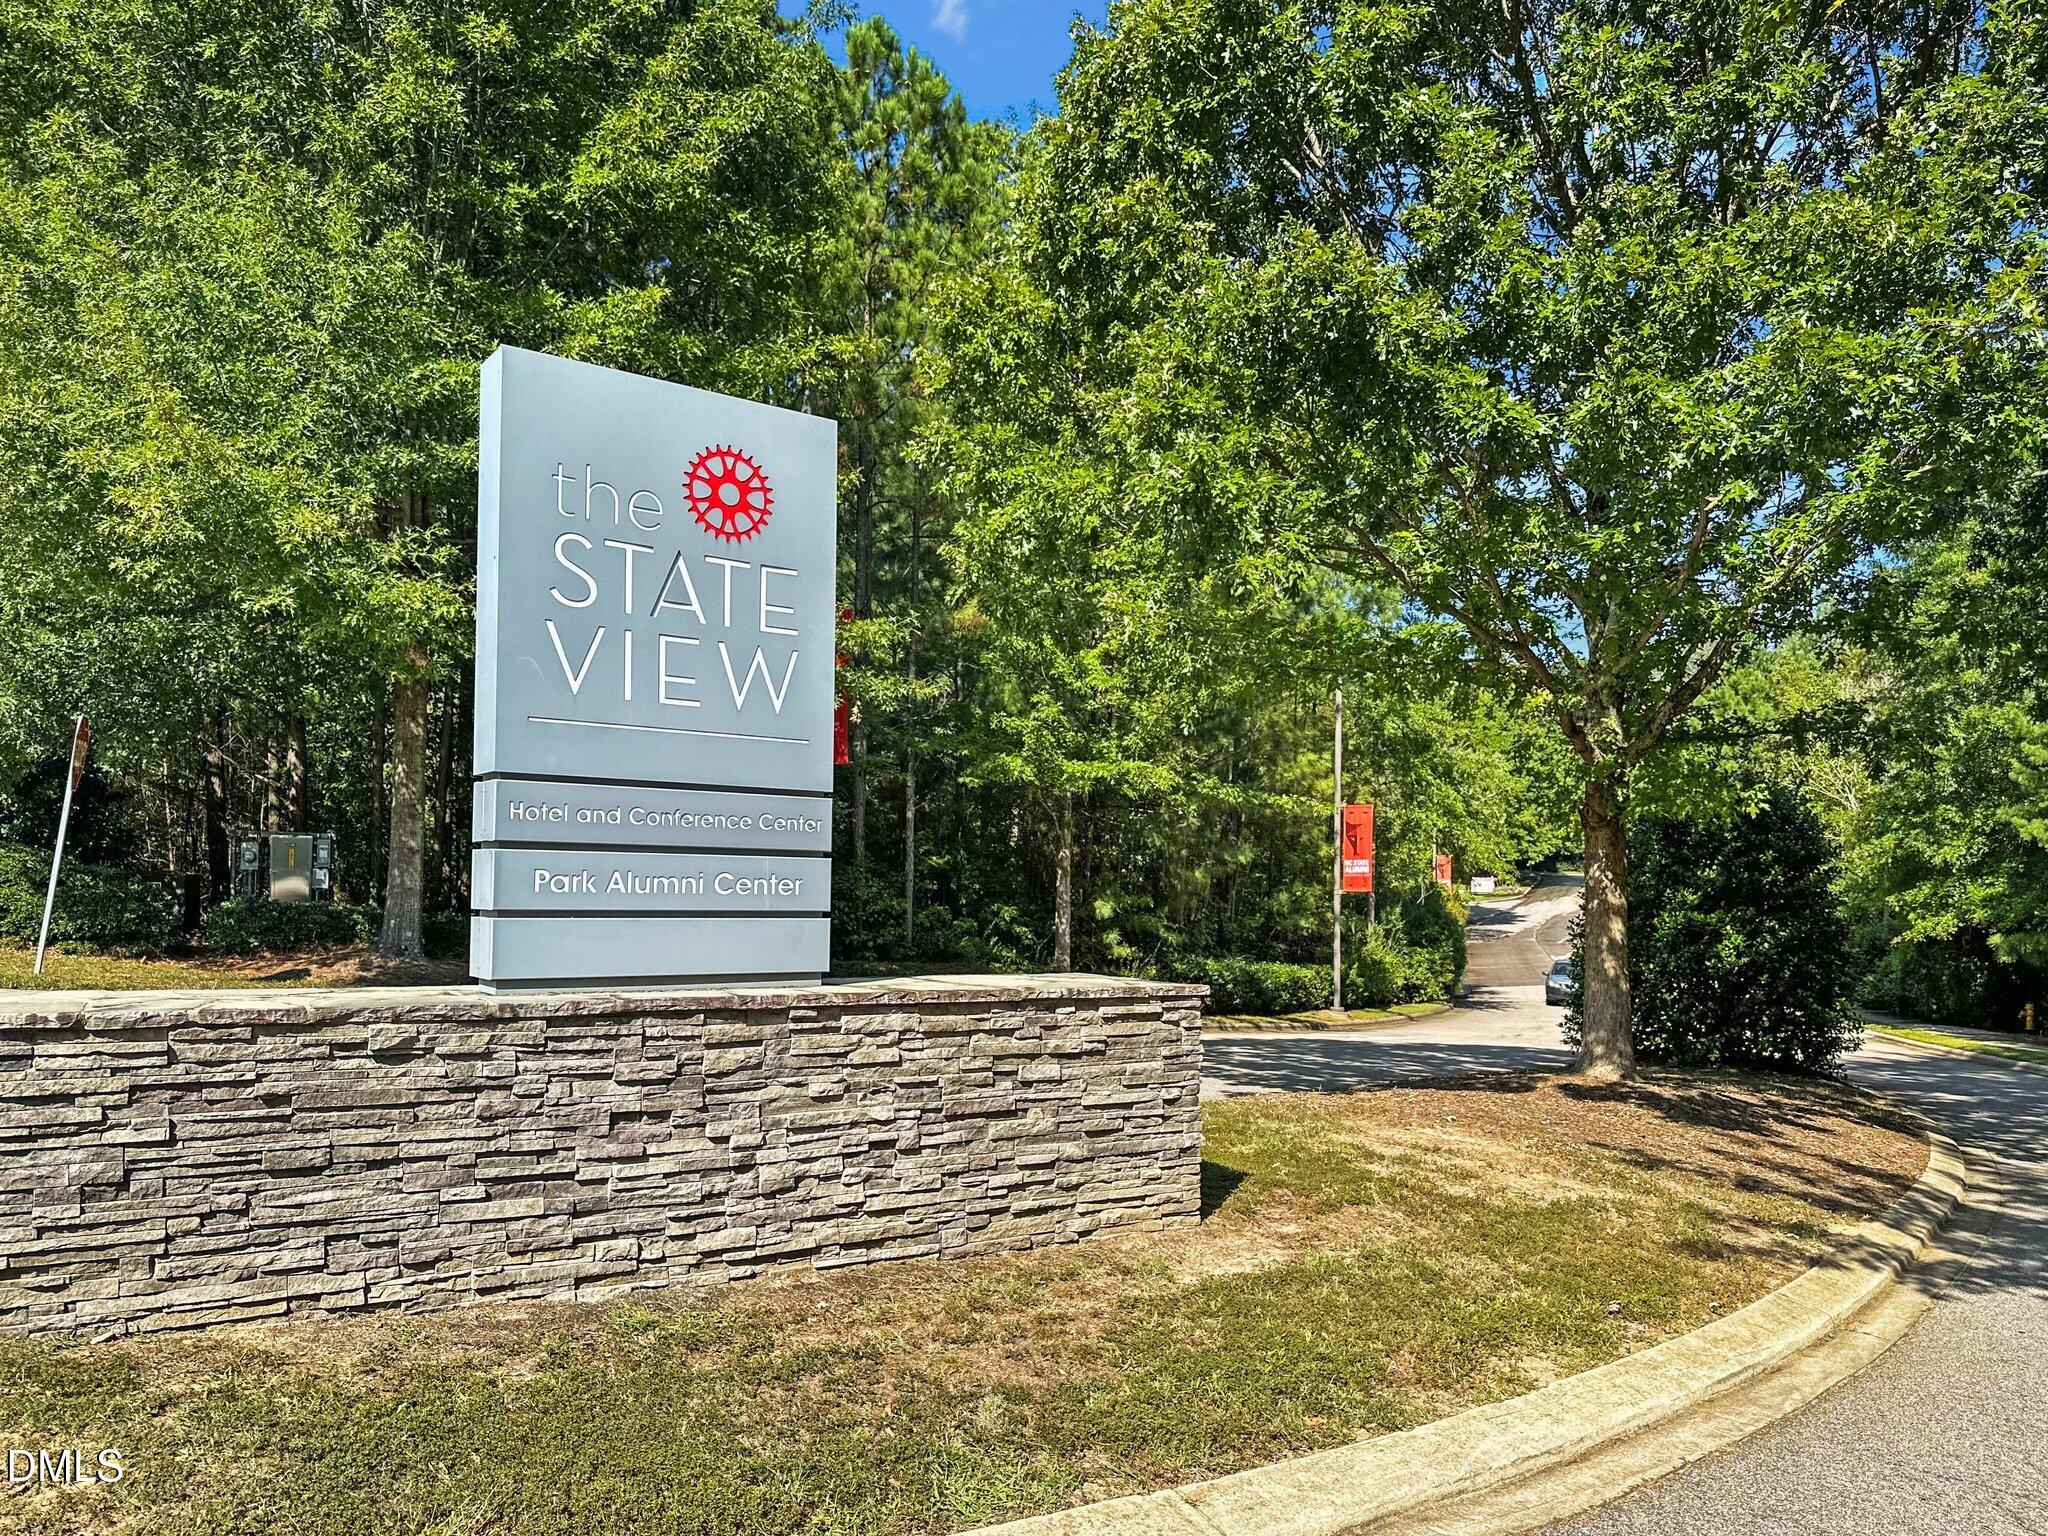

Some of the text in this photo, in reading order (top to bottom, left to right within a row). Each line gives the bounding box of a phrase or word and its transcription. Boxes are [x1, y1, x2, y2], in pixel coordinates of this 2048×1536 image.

[552, 463, 663, 531] the
[550, 532, 799, 636] STATE
[545, 619, 799, 715] VIEW
[509, 801, 823, 833] Hotel and Conference Center
[534, 869, 803, 896] Park Alumni Center
